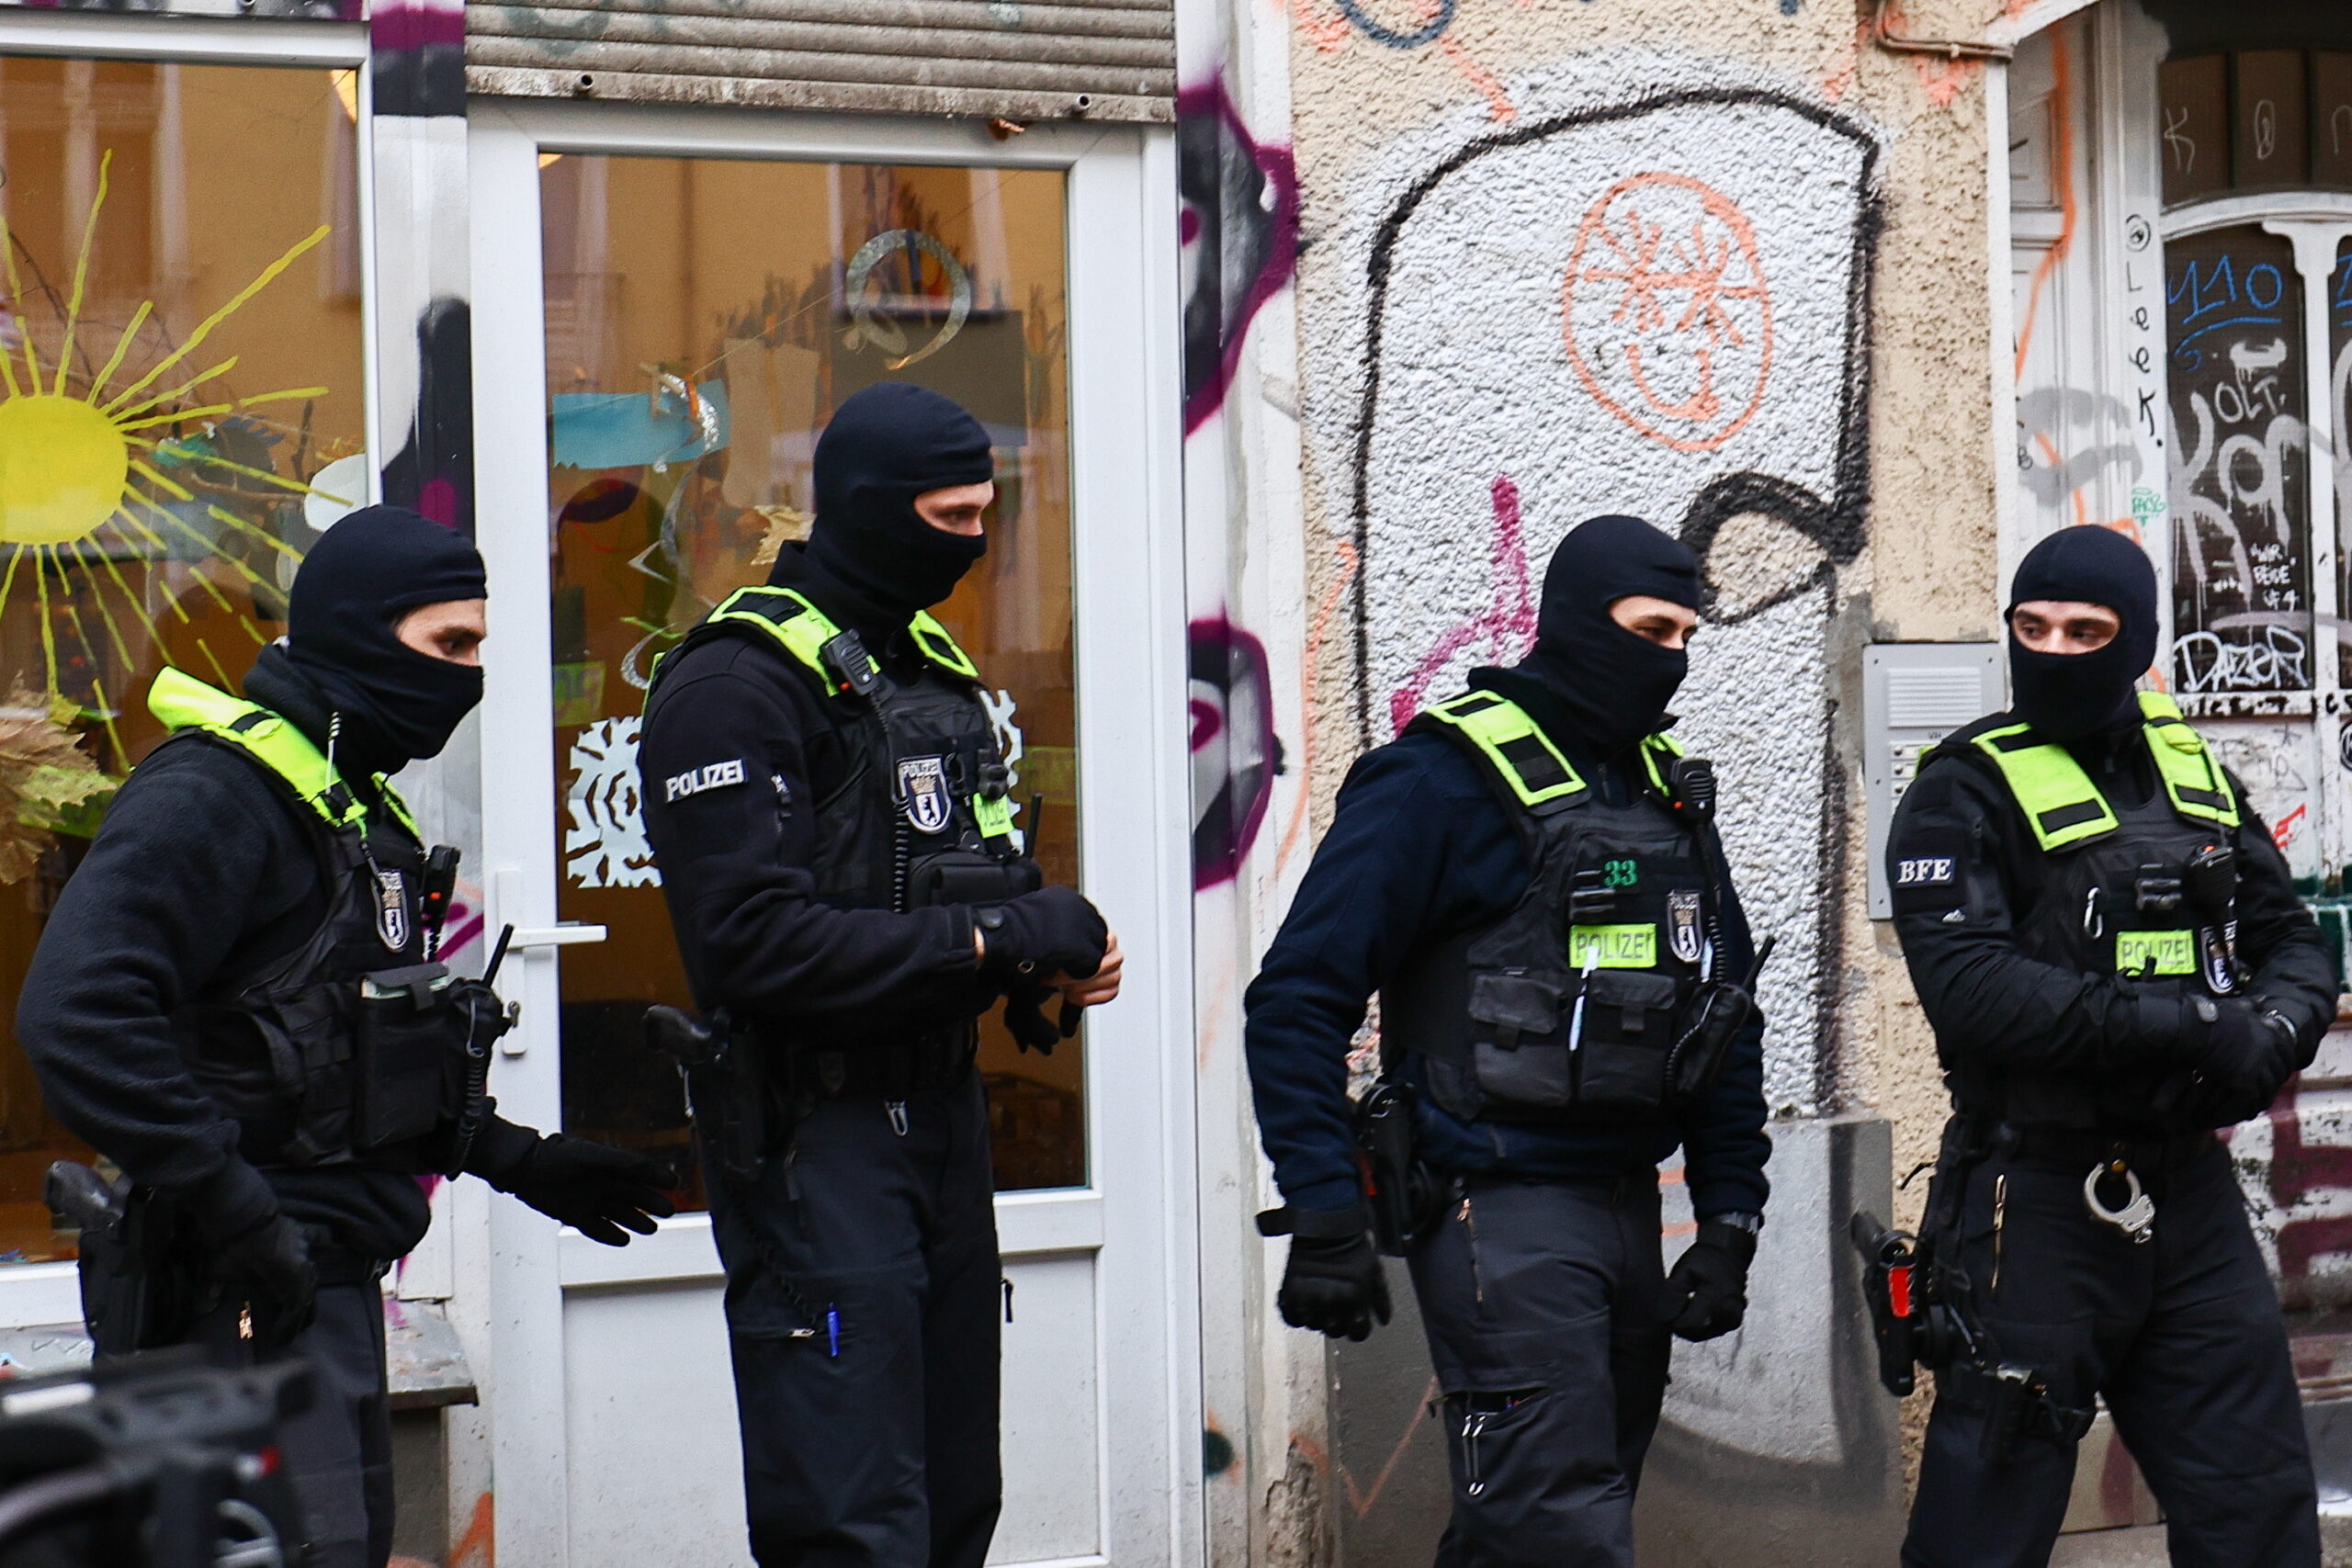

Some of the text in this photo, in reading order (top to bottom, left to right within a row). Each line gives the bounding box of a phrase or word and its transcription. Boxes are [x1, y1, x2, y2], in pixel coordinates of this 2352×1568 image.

[665, 759, 744, 802] POLIZEI
[1603, 858, 1638, 886] 33
[1897, 858, 1951, 883] BFE
